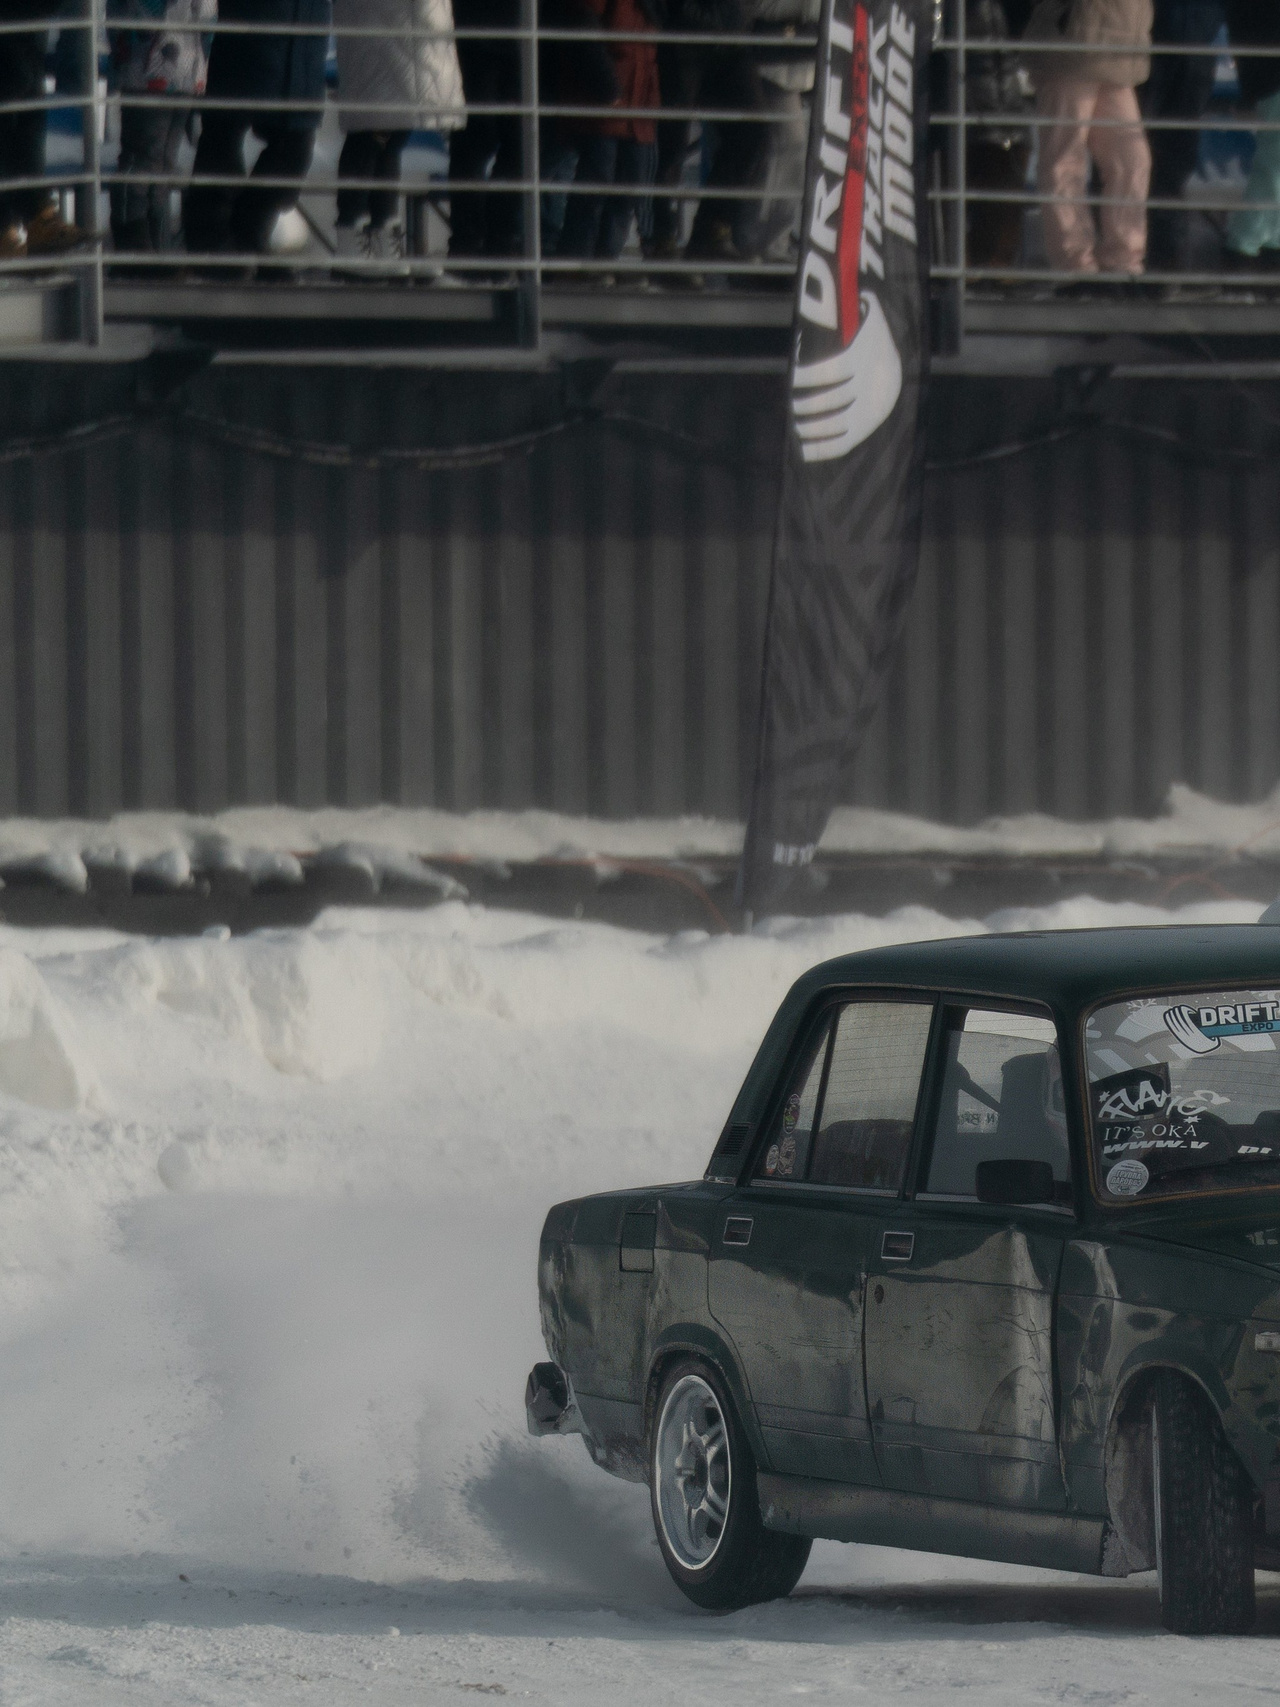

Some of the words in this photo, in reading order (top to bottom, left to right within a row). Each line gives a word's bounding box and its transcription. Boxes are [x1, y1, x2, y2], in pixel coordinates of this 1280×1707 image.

[799, 0, 854, 330] DRIFT
[860, 15, 888, 280] TRACK
[883, 3, 918, 245] MODE
[1199, 1001, 1279, 1027] DRIFT
[1242, 1021, 1274, 1032] EXPO
[1104, 1125, 1145, 1141] IT'S
